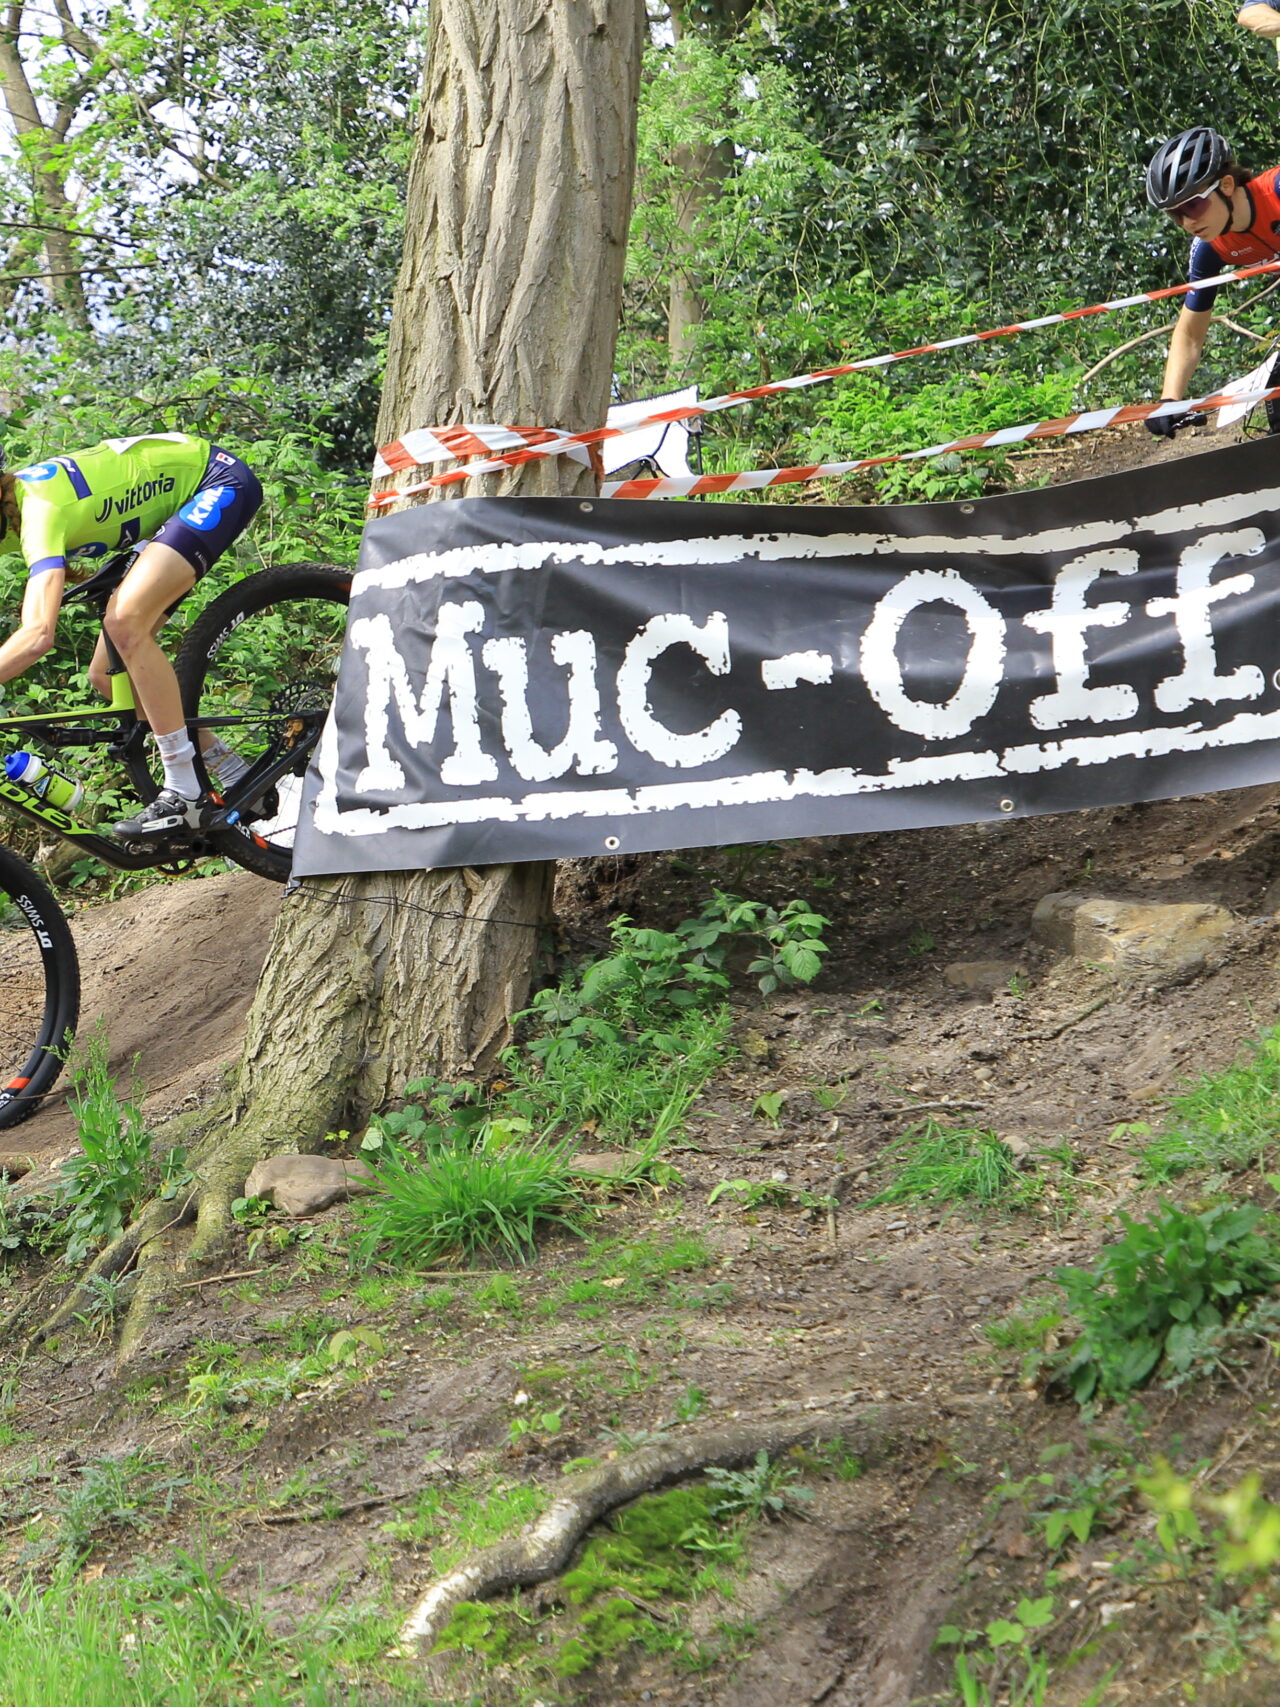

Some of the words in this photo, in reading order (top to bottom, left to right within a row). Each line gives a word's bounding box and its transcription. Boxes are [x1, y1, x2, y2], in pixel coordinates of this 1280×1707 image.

[114, 473, 175, 515] vittoria
[350, 527, 1267, 794] Muc-Off
[241, 713, 290, 722] RIDLEY
[16, 895, 45, 927] SWISS
[36, 930, 53, 948] DT
